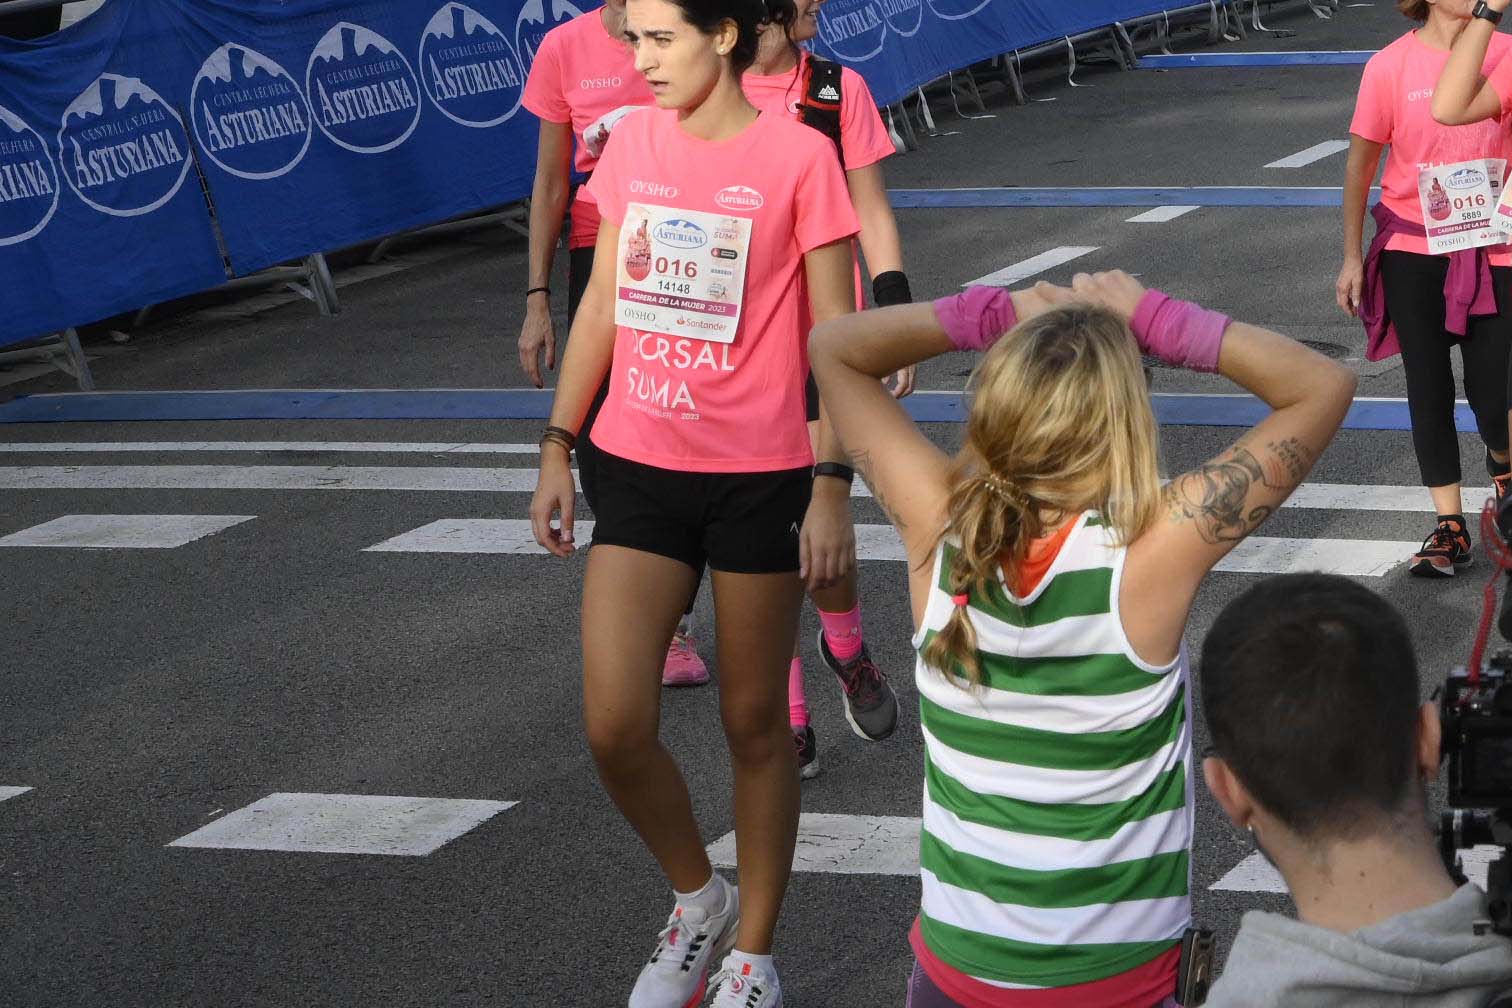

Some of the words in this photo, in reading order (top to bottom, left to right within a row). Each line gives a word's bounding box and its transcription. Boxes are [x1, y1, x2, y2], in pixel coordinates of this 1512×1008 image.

[438, 46, 473, 60] CENTRAL
[473, 39, 505, 54] LECHERA
[327, 68, 362, 83] CENTRAL
[364, 58, 400, 75] LECHERA
[428, 52, 520, 102] ASTURIANA
[580, 76, 622, 90] OYSHO
[213, 90, 252, 107] CENTRAL
[253, 82, 290, 101] LECHERA
[315, 76, 417, 127] ASTURIANA
[81, 122, 122, 142] CENTRAL
[201, 99, 307, 152] ASTURIANA
[70, 128, 184, 189] ASTURIANA
[629, 179, 678, 199] OYSHO
[1453, 193, 1486, 210] 016
[1461, 210, 1482, 221] 5889
[656, 227, 703, 245] ASTURIANA
[1437, 225, 1463, 235] CARRERA
[1463, 224, 1471, 232] DE
[1472, 223, 1480, 231] LA
[1437, 236, 1465, 248] OYSHO
[655, 256, 698, 278] 016
[658, 280, 690, 295] 14148
[628, 292, 657, 303] CARRERA
[658, 296, 670, 304] DE
[670, 298, 680, 307] LA
[681, 300, 705, 310] MUJER
[708, 304, 726, 313] 2023
[624, 307, 656, 322] OYSHO
[686, 318, 728, 332] Santander
[627, 367, 696, 410] SUMA
